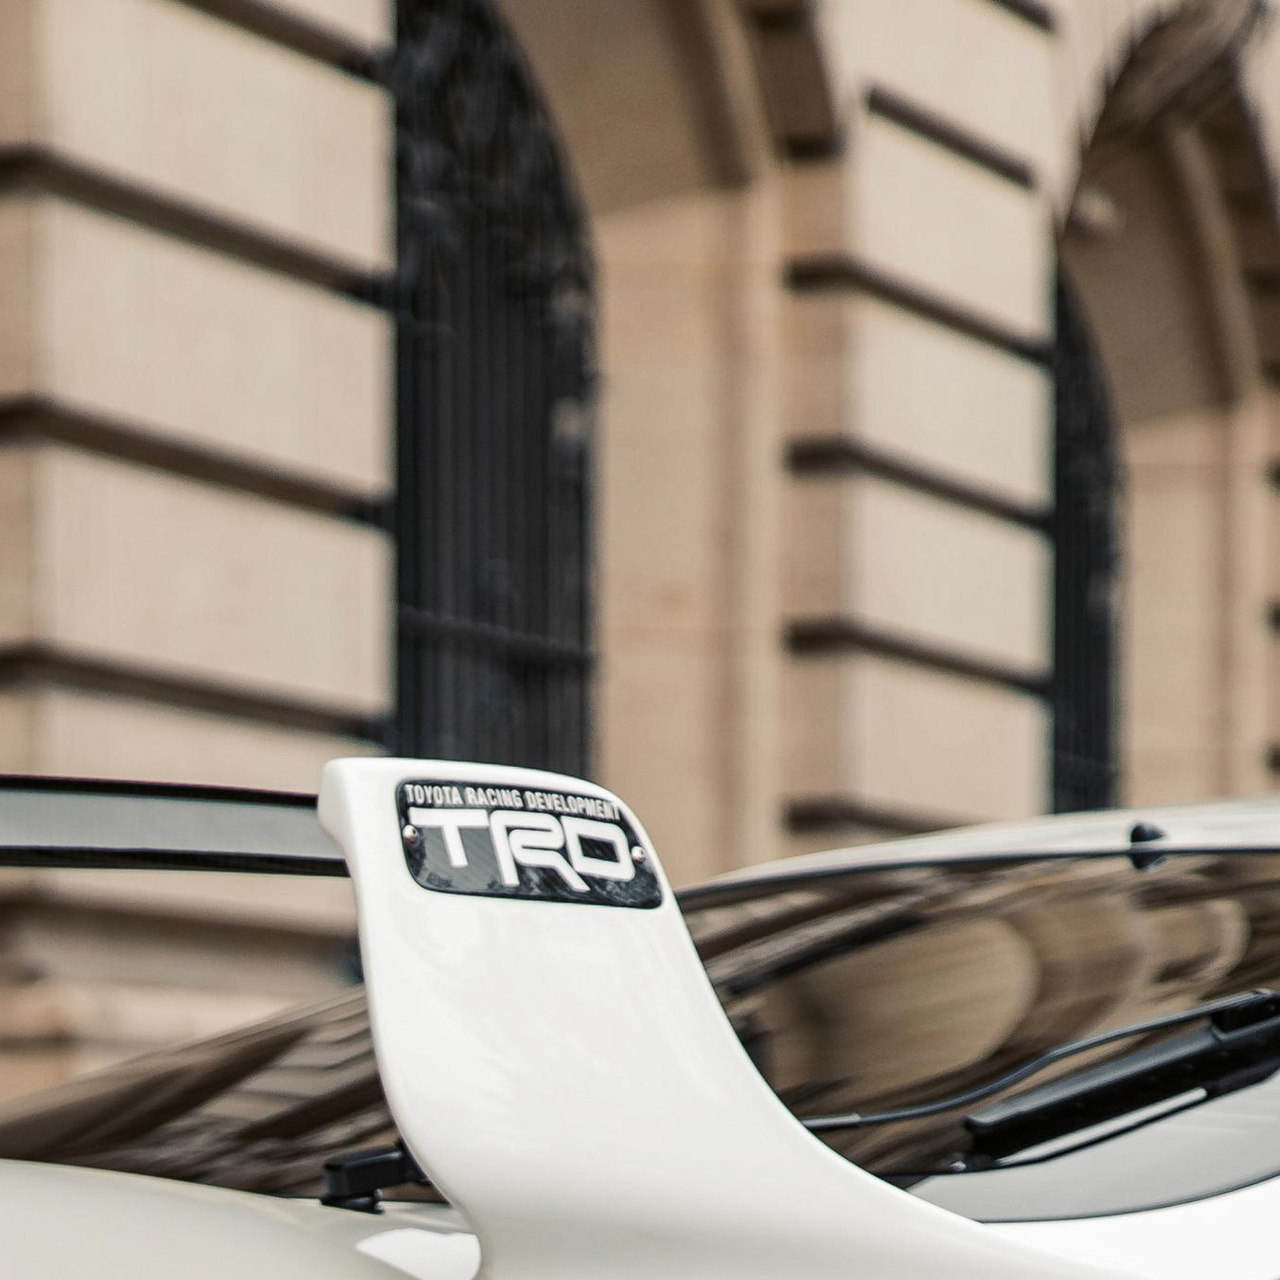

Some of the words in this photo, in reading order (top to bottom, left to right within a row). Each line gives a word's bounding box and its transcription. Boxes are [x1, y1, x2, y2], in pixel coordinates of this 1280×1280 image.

[405, 784, 463, 805] TOYOTA
[466, 787, 523, 808] RACING
[524, 791, 621, 820] DEVELOPMENT
[409, 806, 636, 893] TRD
